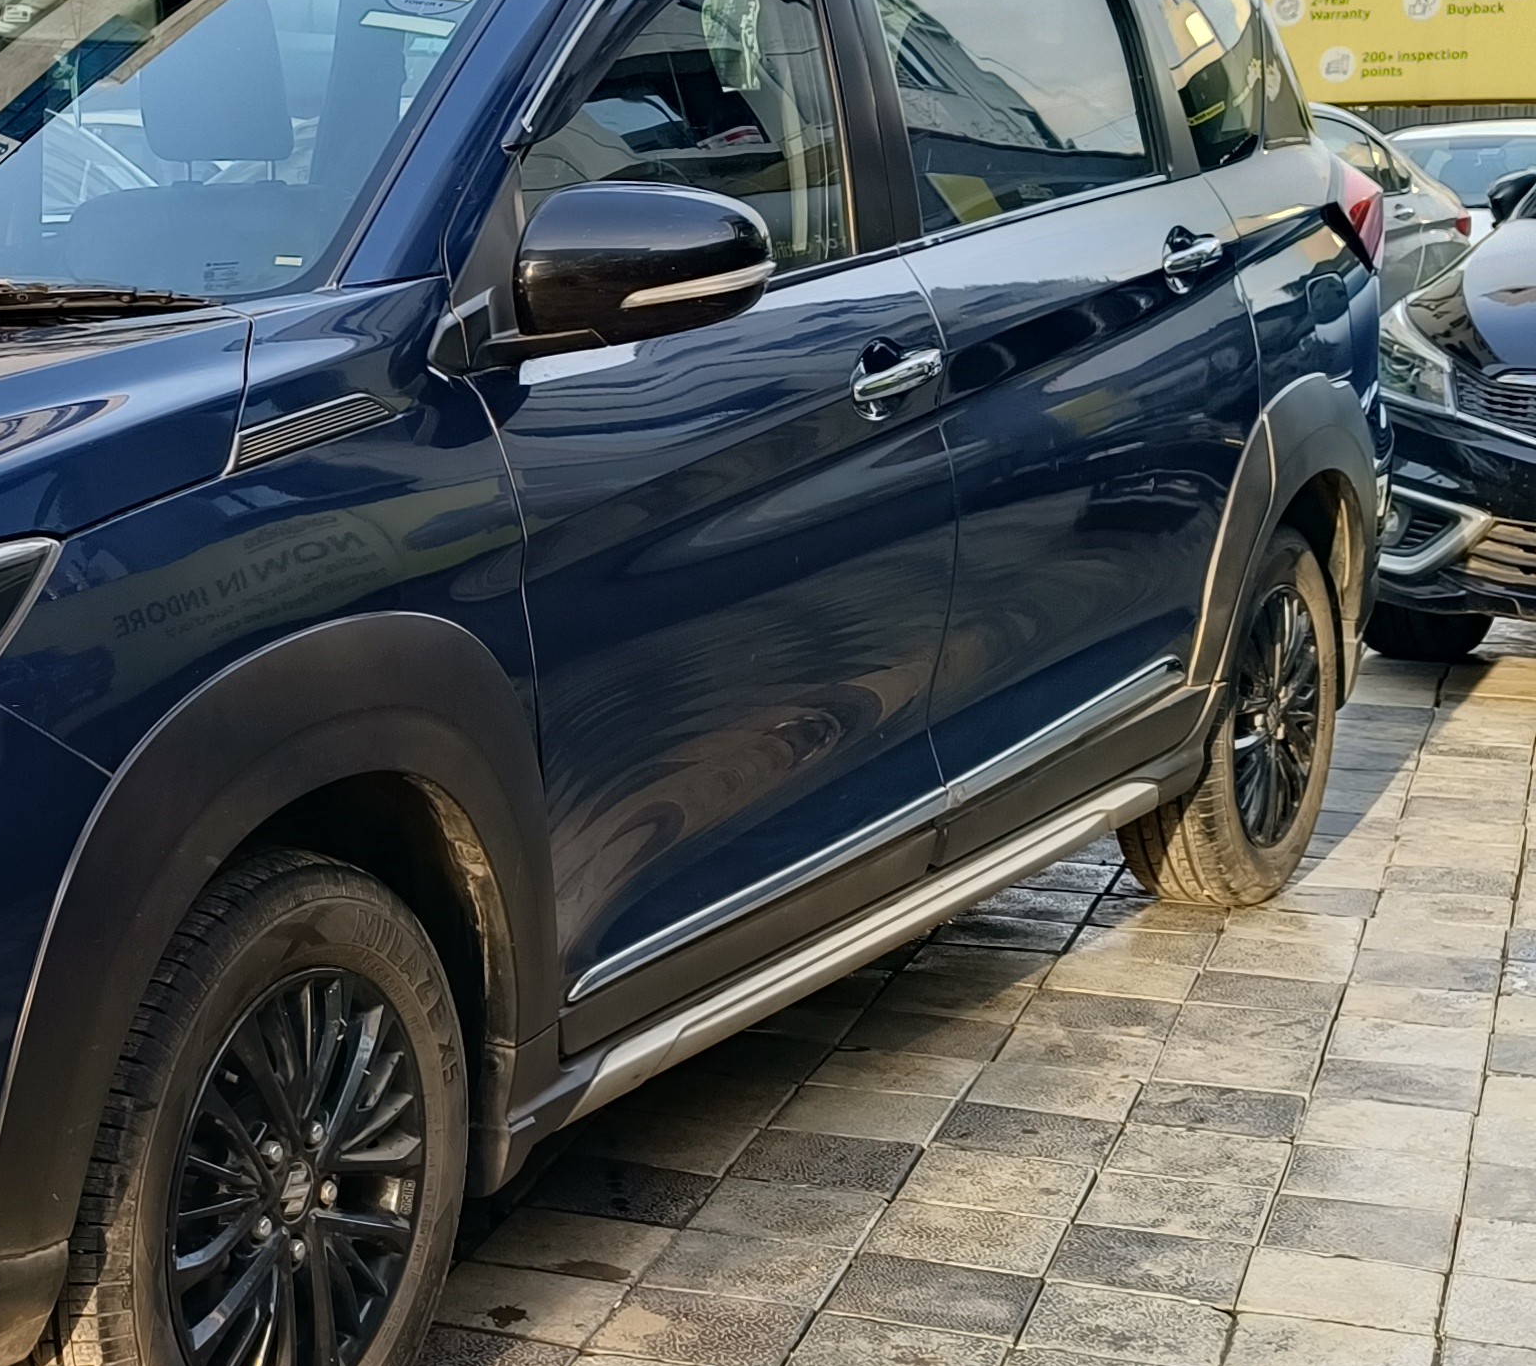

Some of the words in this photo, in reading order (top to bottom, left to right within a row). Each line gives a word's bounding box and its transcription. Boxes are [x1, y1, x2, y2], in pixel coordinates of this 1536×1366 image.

[1311, 7, 1371, 22] Warranty
[1447, 1, 1505, 17] Buyback
[1362, 50, 1394, 63] 200+
[1397, 47, 1469, 64] inspection
[1361, 65, 1403, 79] points
